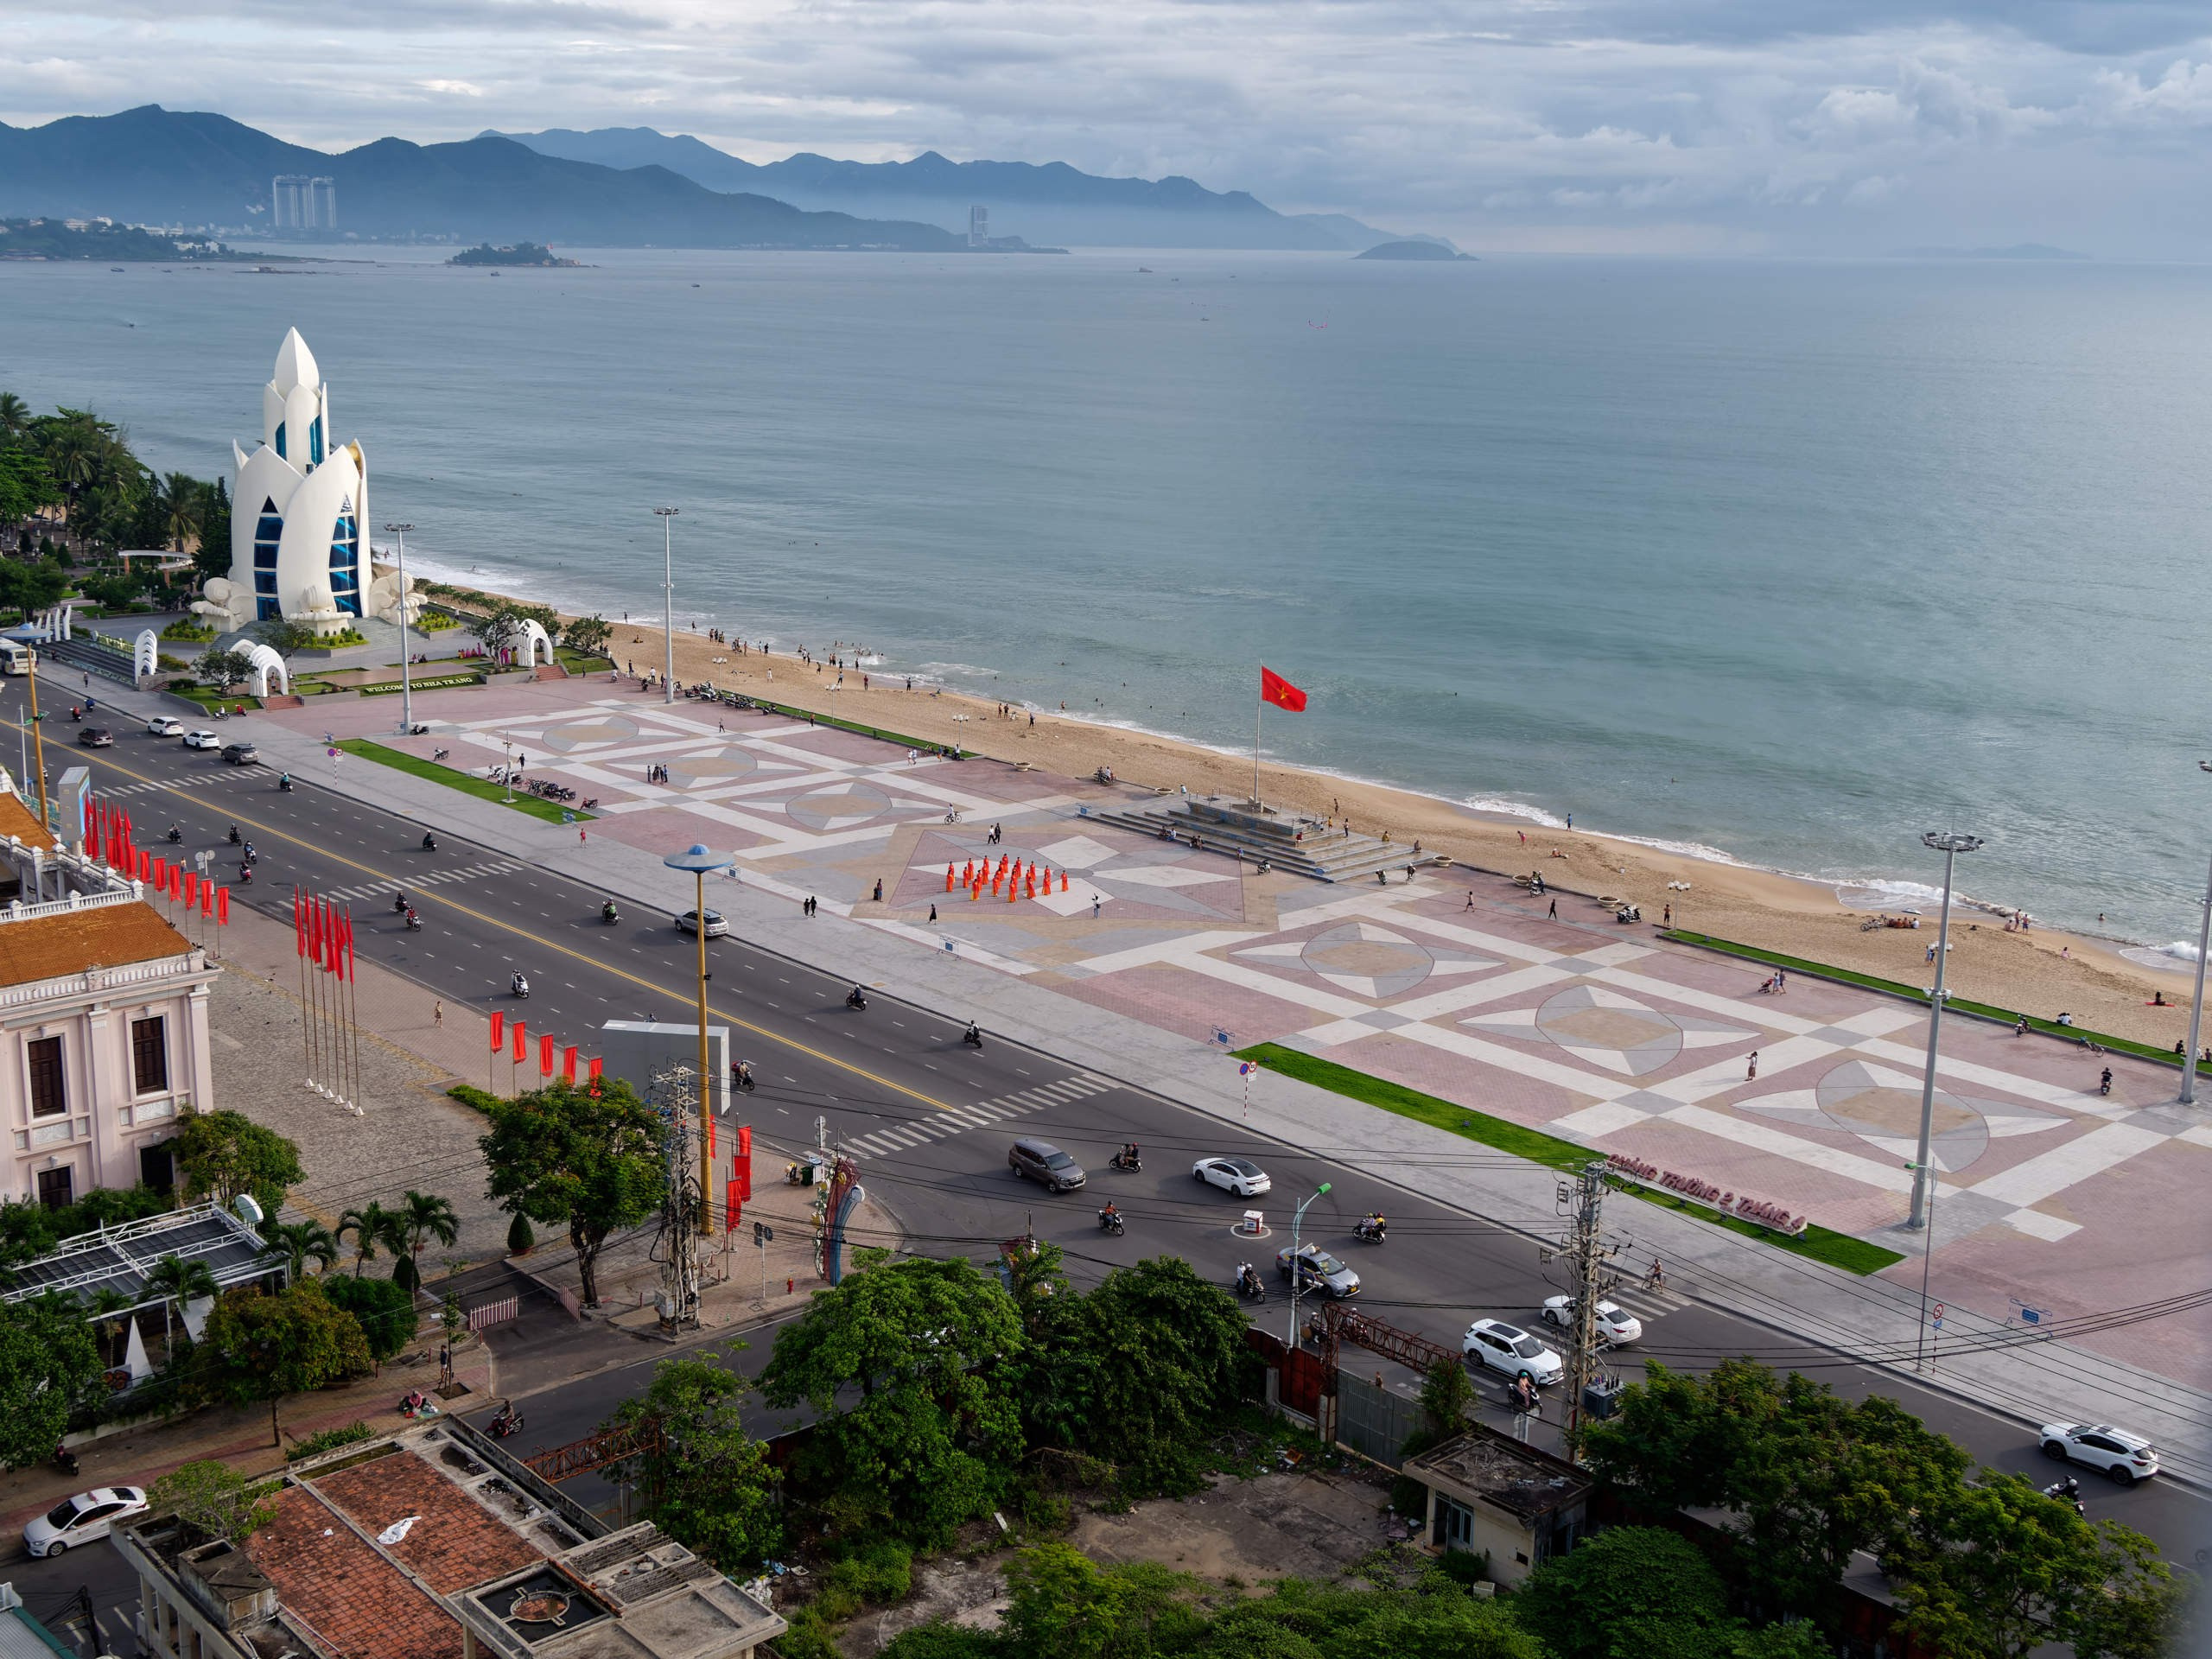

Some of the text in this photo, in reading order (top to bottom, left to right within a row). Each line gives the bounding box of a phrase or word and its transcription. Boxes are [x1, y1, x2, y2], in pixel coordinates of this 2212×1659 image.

[442, 677, 473, 686] TRANG
[1719, 1192, 1734, 1207] 2
[1736, 1197, 1790, 1227] THÁNG
